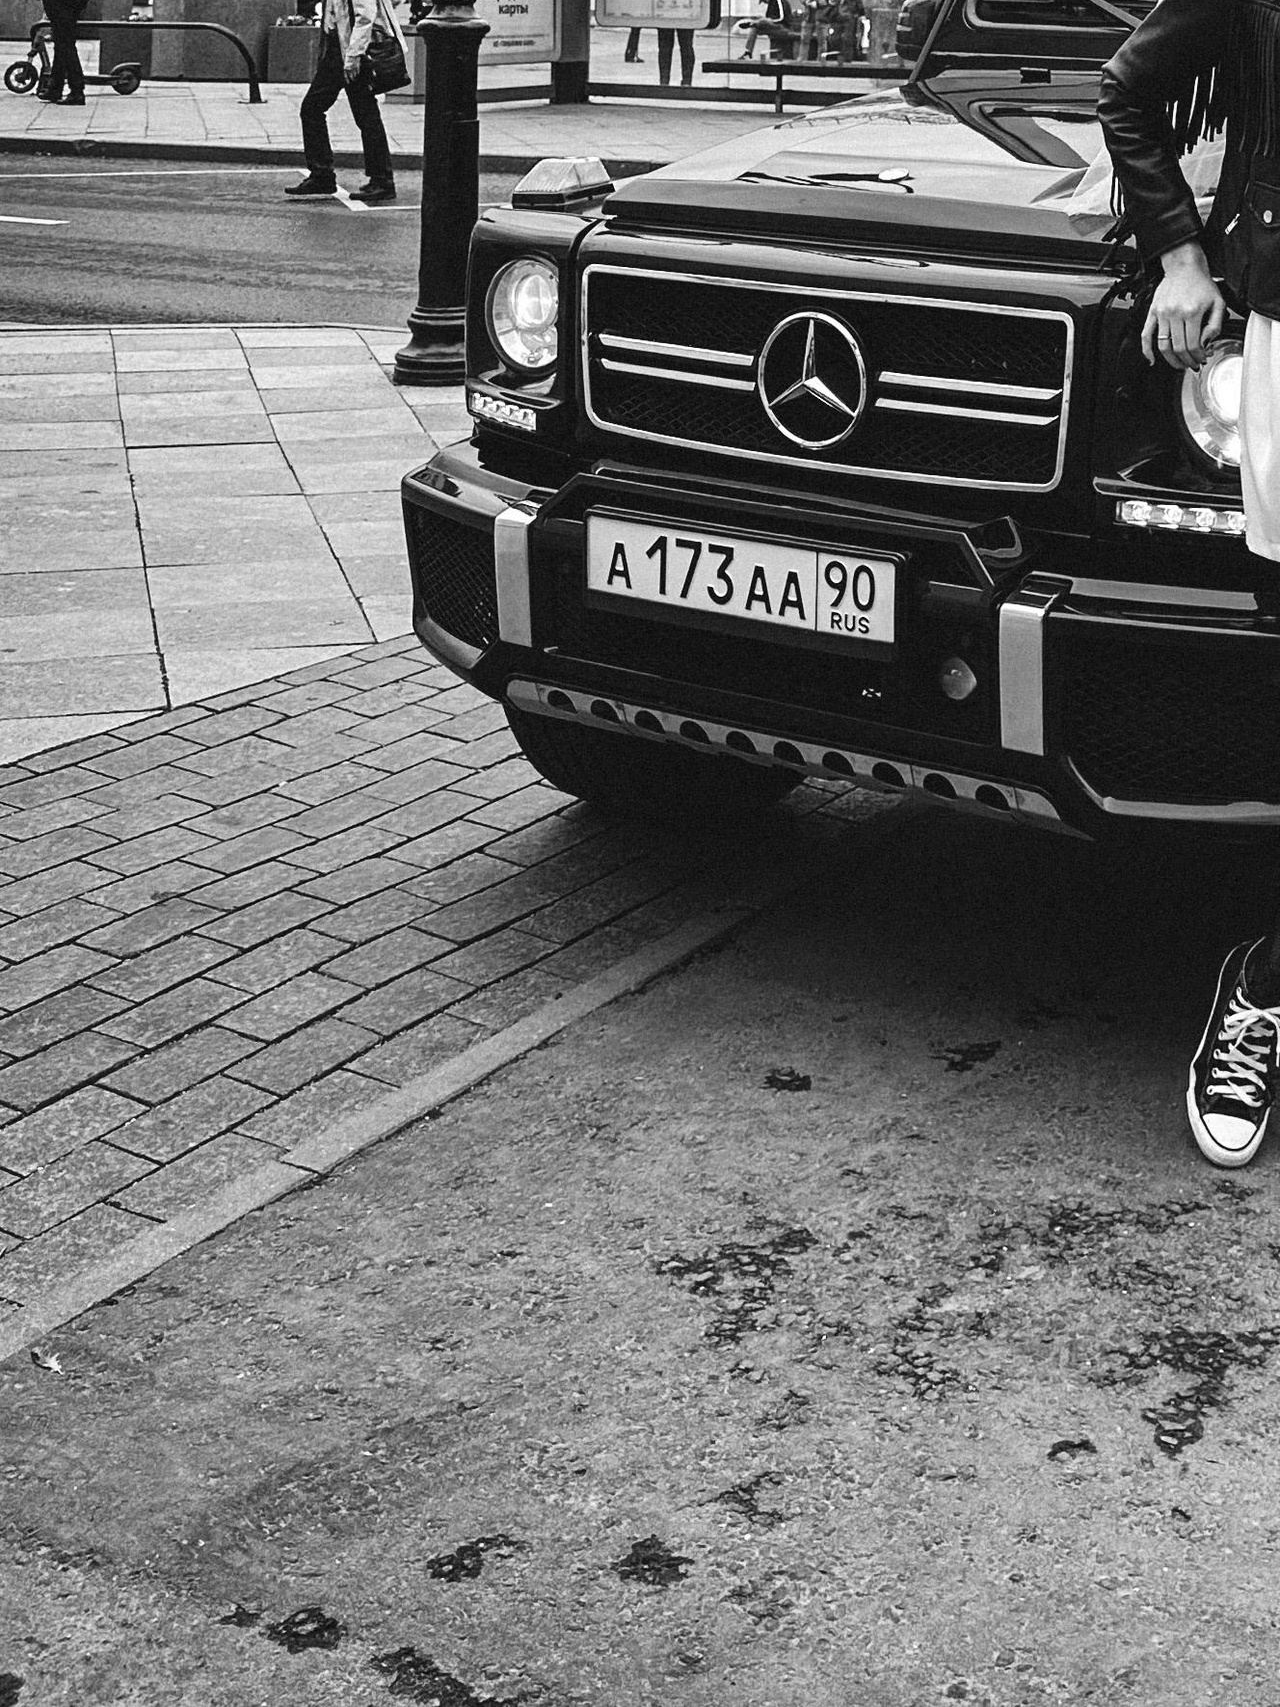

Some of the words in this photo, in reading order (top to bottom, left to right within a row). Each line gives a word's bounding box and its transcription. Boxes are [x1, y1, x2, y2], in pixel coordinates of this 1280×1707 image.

[498, 4, 529, 17] карты
[824, 560, 876, 612] 90
[830, 611, 870, 635] RUS
